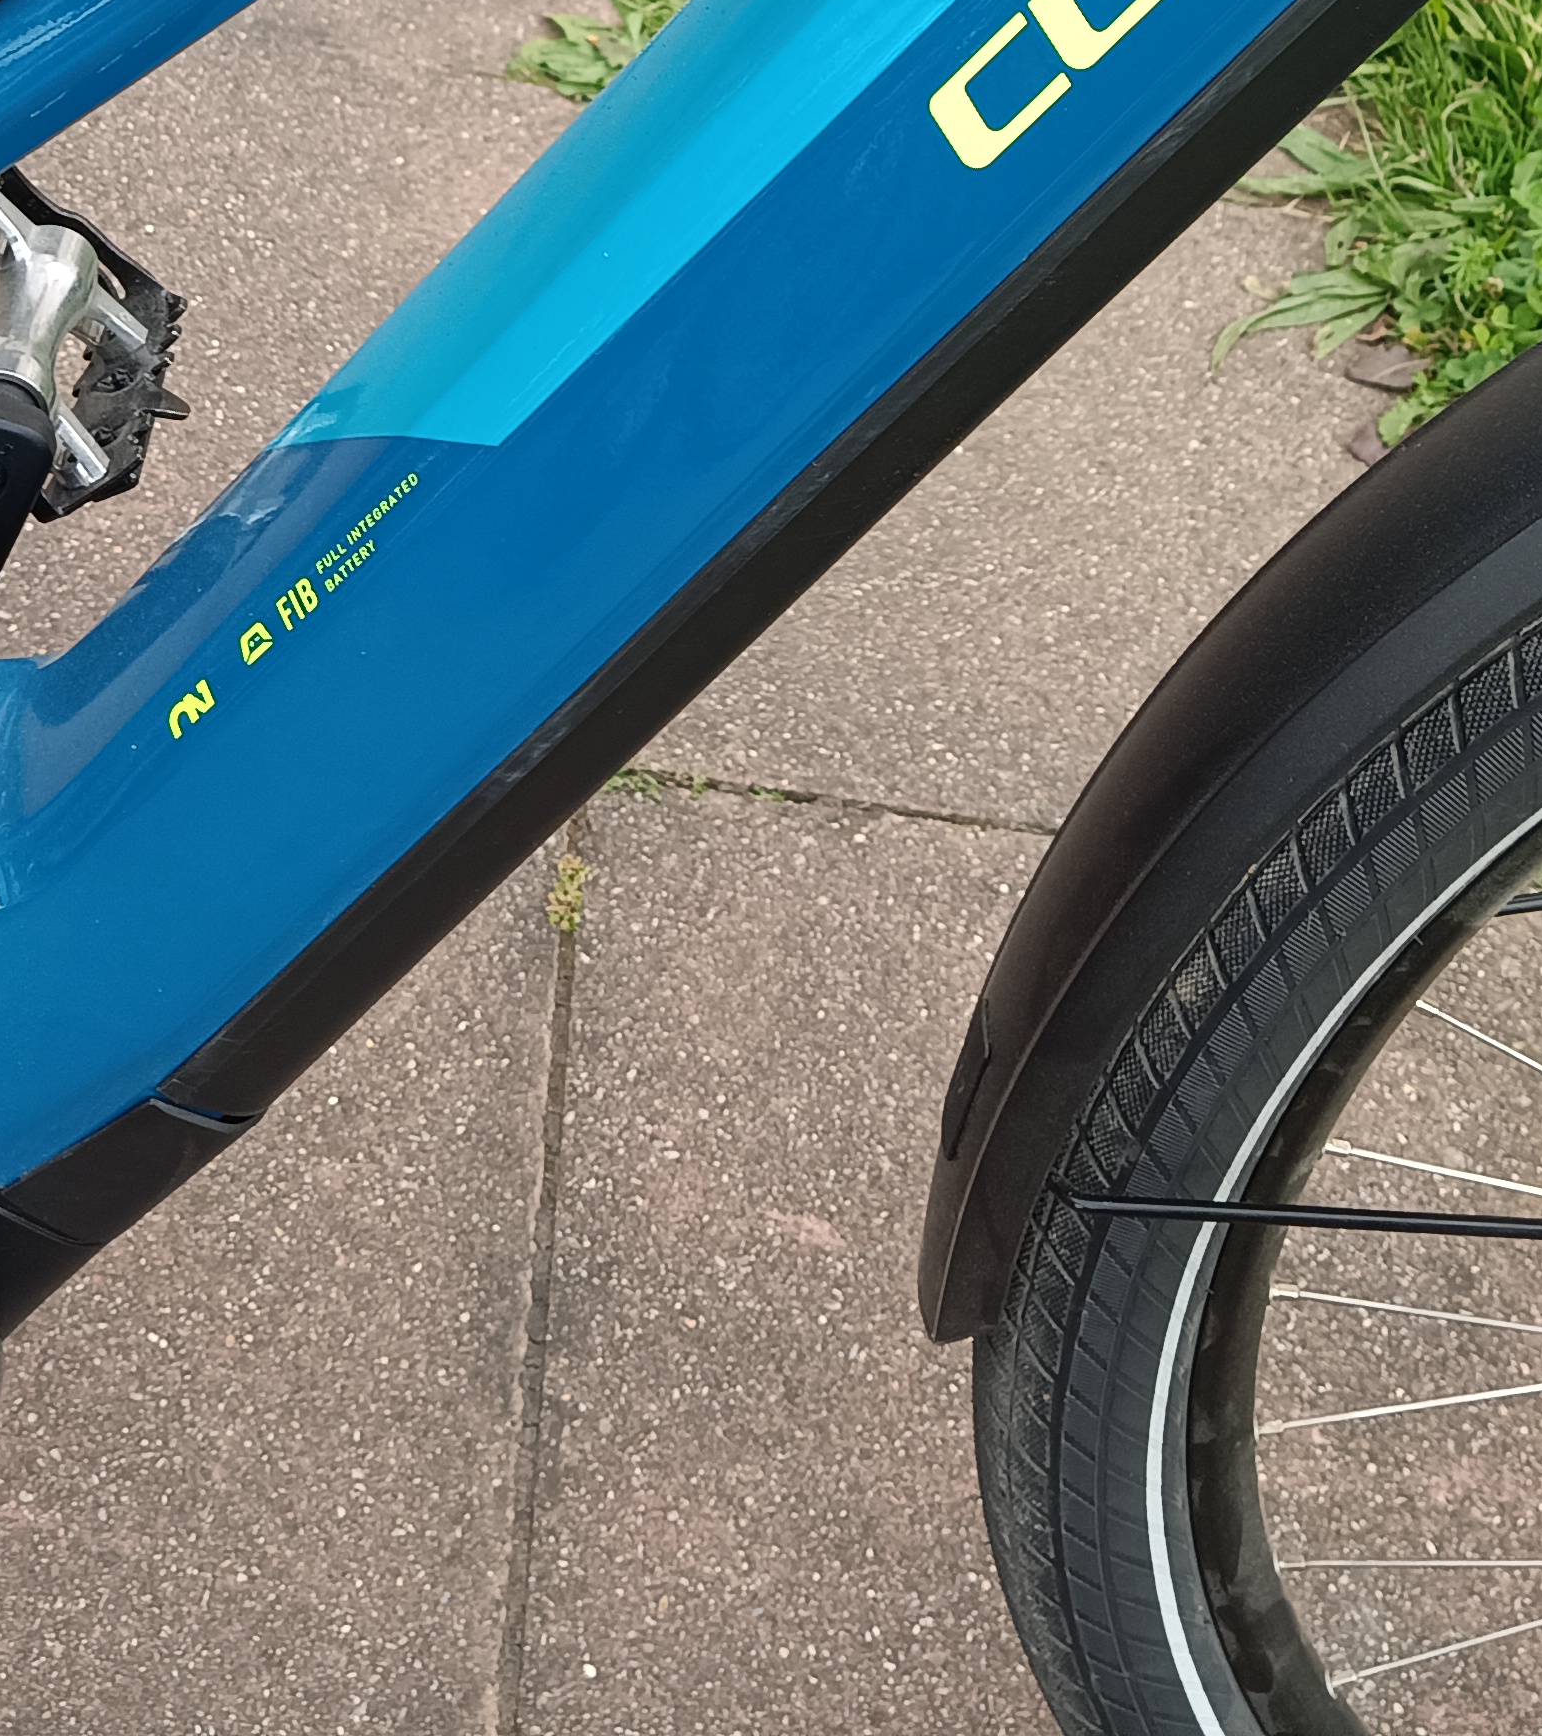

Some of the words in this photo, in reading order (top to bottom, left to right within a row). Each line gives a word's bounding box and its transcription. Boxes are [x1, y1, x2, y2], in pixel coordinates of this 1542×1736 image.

[315, 543, 348, 575] FULL
[346, 472, 419, 546] INTEGRATED
[324, 539, 376, 593] BATTERY
[275, 577, 319, 631] FIB
